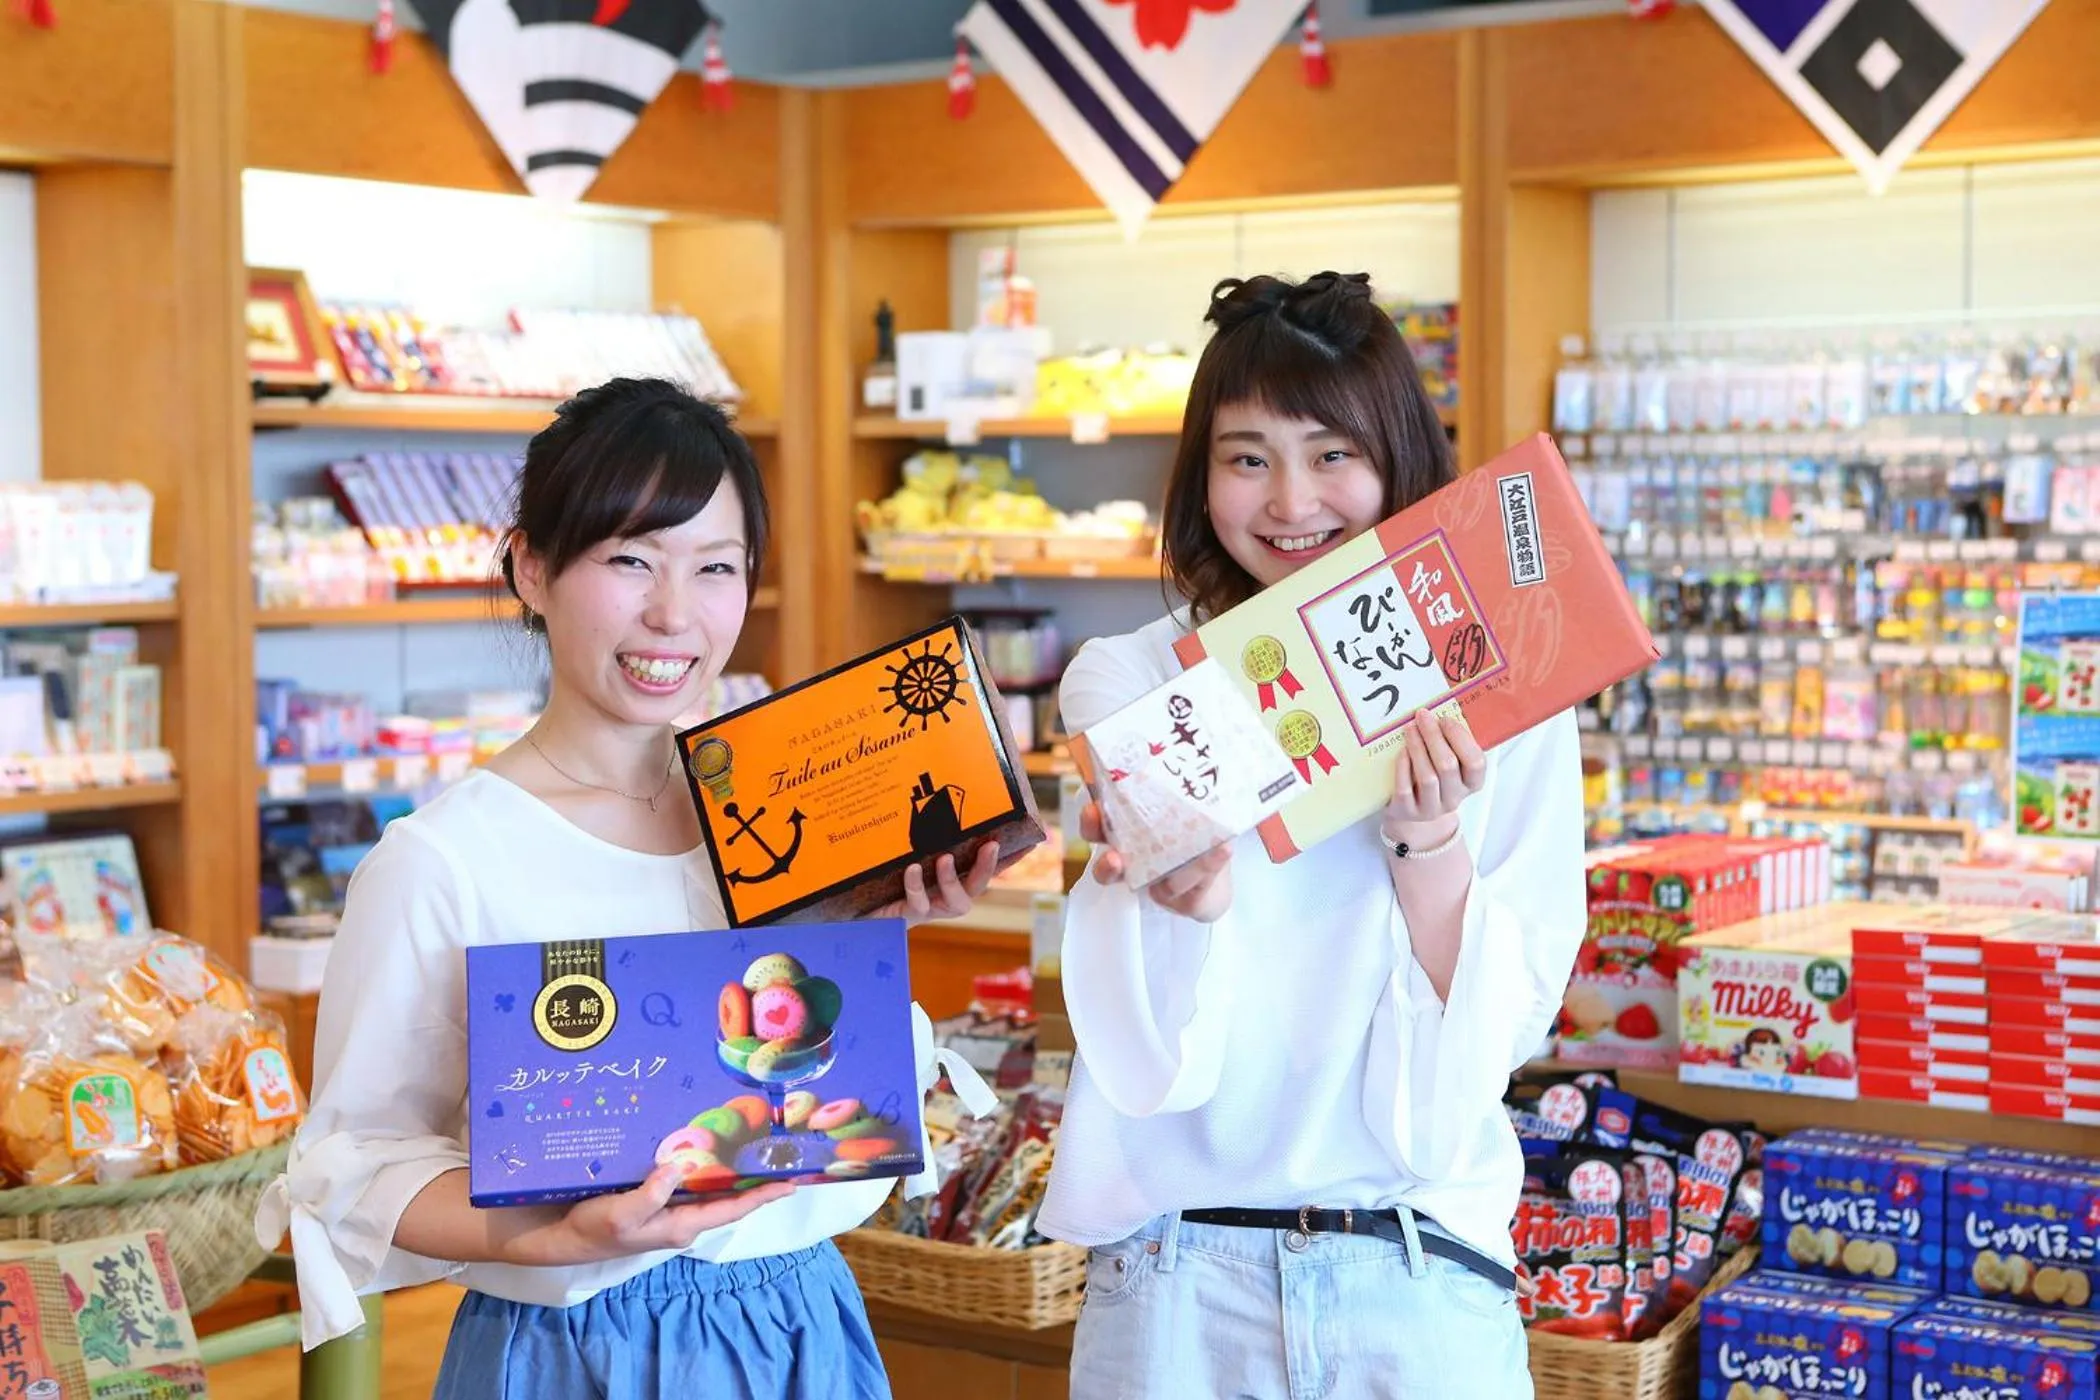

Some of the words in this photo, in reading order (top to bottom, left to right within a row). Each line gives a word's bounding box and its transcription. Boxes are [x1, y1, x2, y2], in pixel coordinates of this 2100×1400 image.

[1507, 483, 1536, 577] 大江戸温泉物語
[1408, 560, 1465, 627] 和風
[788, 703, 877, 749] NAGASAKI
[768, 757, 817, 797] Tuile
[820, 755, 842, 776] au
[550, 998, 600, 1019] 長崎
[551, 1017, 599, 1028] NAGASAKI
[640, 992, 682, 1028] Q
[494, 1056, 668, 1092] カルッテベイク
[1779, 1185, 1921, 1238] じゃがほっこり
[1718, 1341, 1868, 1396] じゃがほっこり
